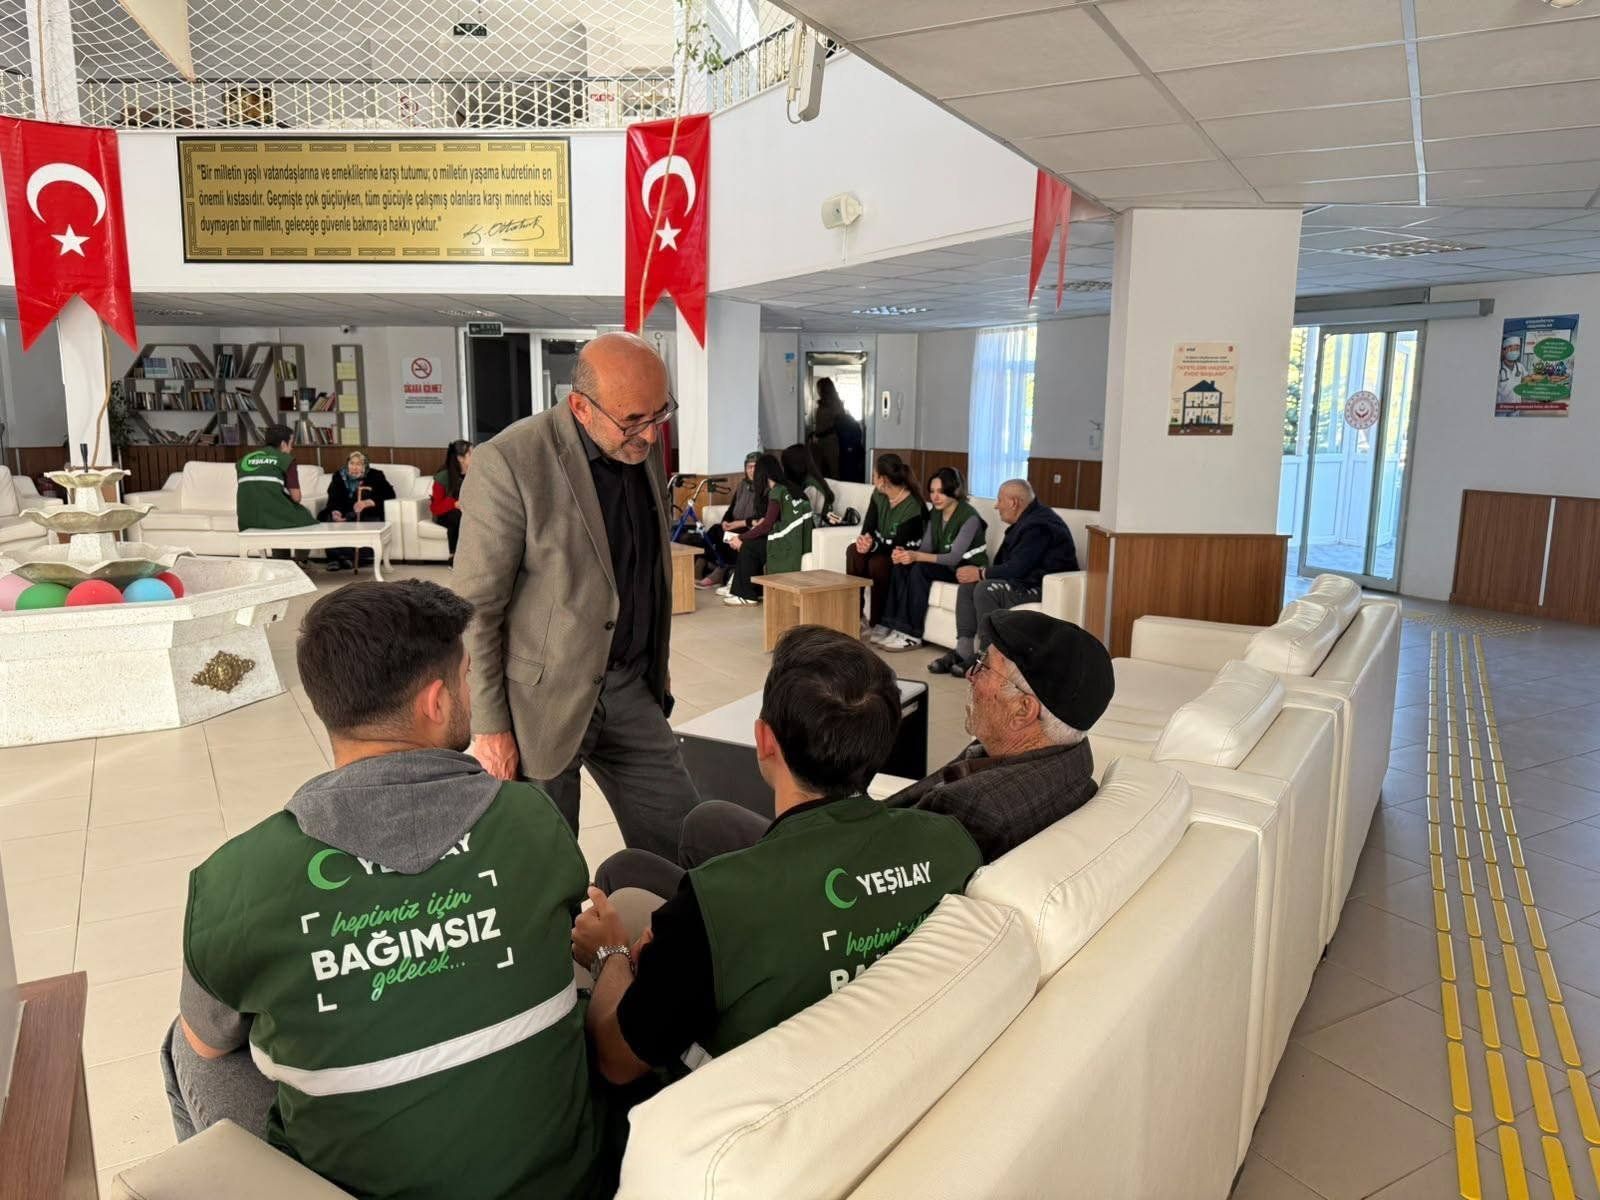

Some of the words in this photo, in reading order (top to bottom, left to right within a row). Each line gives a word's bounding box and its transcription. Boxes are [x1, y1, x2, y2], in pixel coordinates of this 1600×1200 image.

[197, 164, 212, 180] "Bir
[214, 164, 241, 180] milletin
[244, 164, 261, 184] yaşlı
[264, 164, 319, 184] vatandaşlarına
[321, 169, 330, 180] ve
[332, 164, 378, 180] emeklilerine
[380, 164, 400, 184] karşı
[400, 165, 431, 182] tutumu;
[432, 169, 438, 180] o
[440, 164, 468, 180] milletin
[469, 169, 499, 184] yaşama
[501, 164, 540, 180] kudretinin
[542, 168, 552, 180] en
[199, 190, 224, 206] önemli
[226, 190, 265, 206] kıstasıdır.
[266, 189, 303, 209] Geçmişte
[305, 190, 319, 209] çok
[321, 190, 363, 209] güçlüyken,
[365, 190, 380, 206] tüm
[382, 190, 413, 209] gücüyle
[415, 190, 448, 209] çalışmış
[450, 190, 481, 206] olanlara
[483, 190, 502, 209] karşı
[505, 190, 531, 206] minnet
[533, 190, 553, 206] hissi
[200, 216, 239, 235] duymayan
[240, 216, 252, 231] bir
[253, 216, 284, 234] milletin,
[285, 216, 319, 235] geleceğe
[321, 216, 351, 235] güvenle
[352, 216, 387, 235] bakmaya
[389, 216, 410, 231] hakkı
[411, 215, 442, 235] yoktur."
[856, 861, 932, 895] YEŞİLAY
[331, 899, 420, 937] hepimiz
[427, 888, 472, 918] için
[311, 907, 501, 981] BAĞIMSIZ
